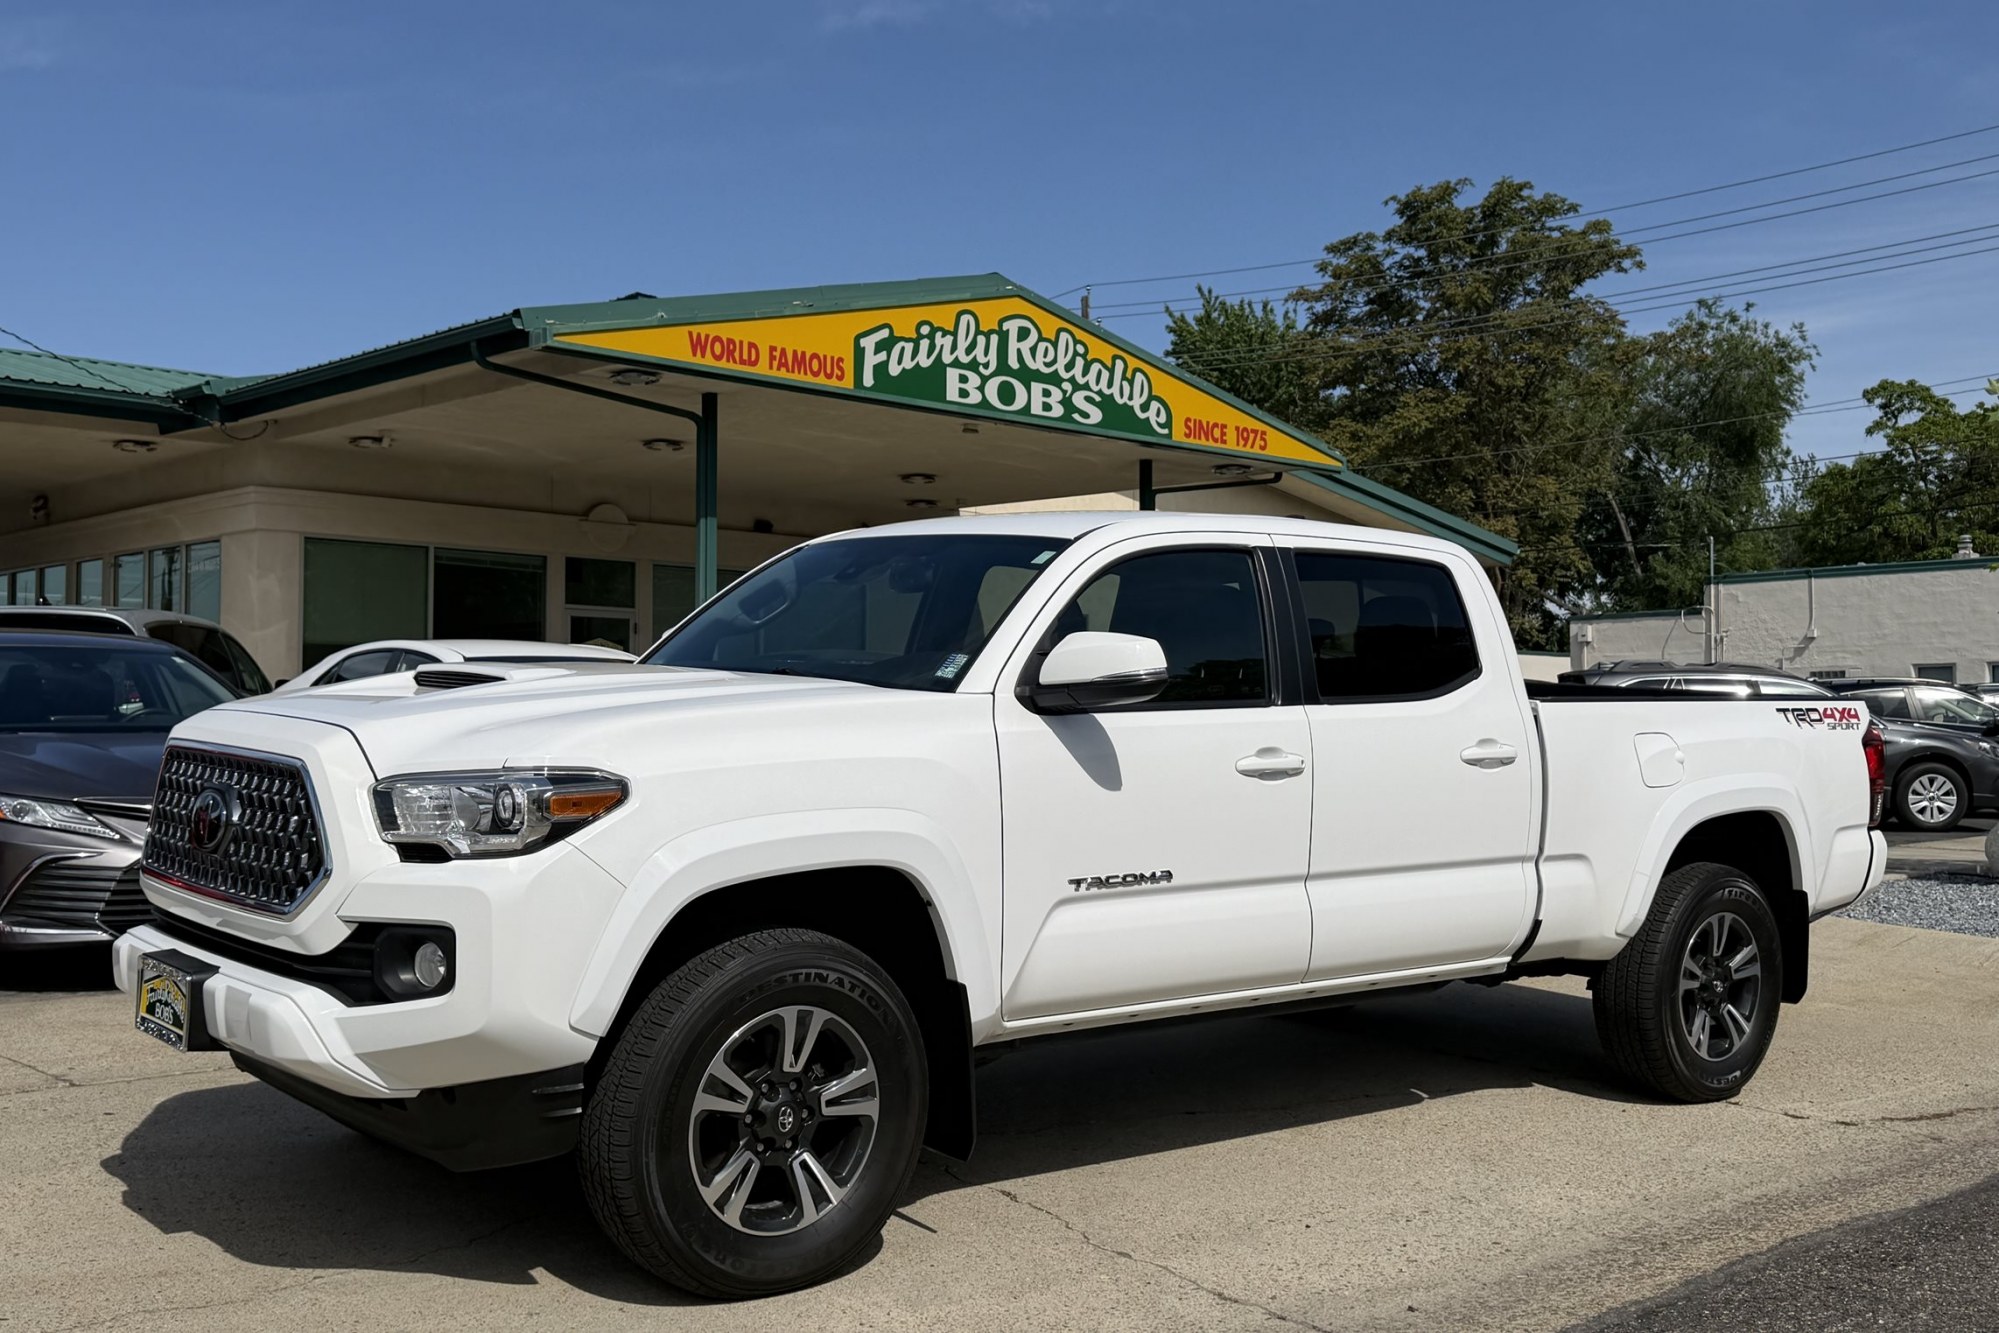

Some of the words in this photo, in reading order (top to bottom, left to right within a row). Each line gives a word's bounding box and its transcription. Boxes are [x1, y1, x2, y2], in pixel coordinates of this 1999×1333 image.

[687, 330, 761, 368] WORLD
[768, 345, 846, 382] FAMOUS
[859, 313, 999, 388] Fairly
[1002, 318, 1169, 435] Reliable
[946, 366, 1103, 425] BOB'S
[1183, 416, 1228, 445] SINCE
[1234, 425, 1268, 452] 1975
[1826, 722, 1861, 731] SPORT
[1067, 869, 1174, 892] TACOMA
